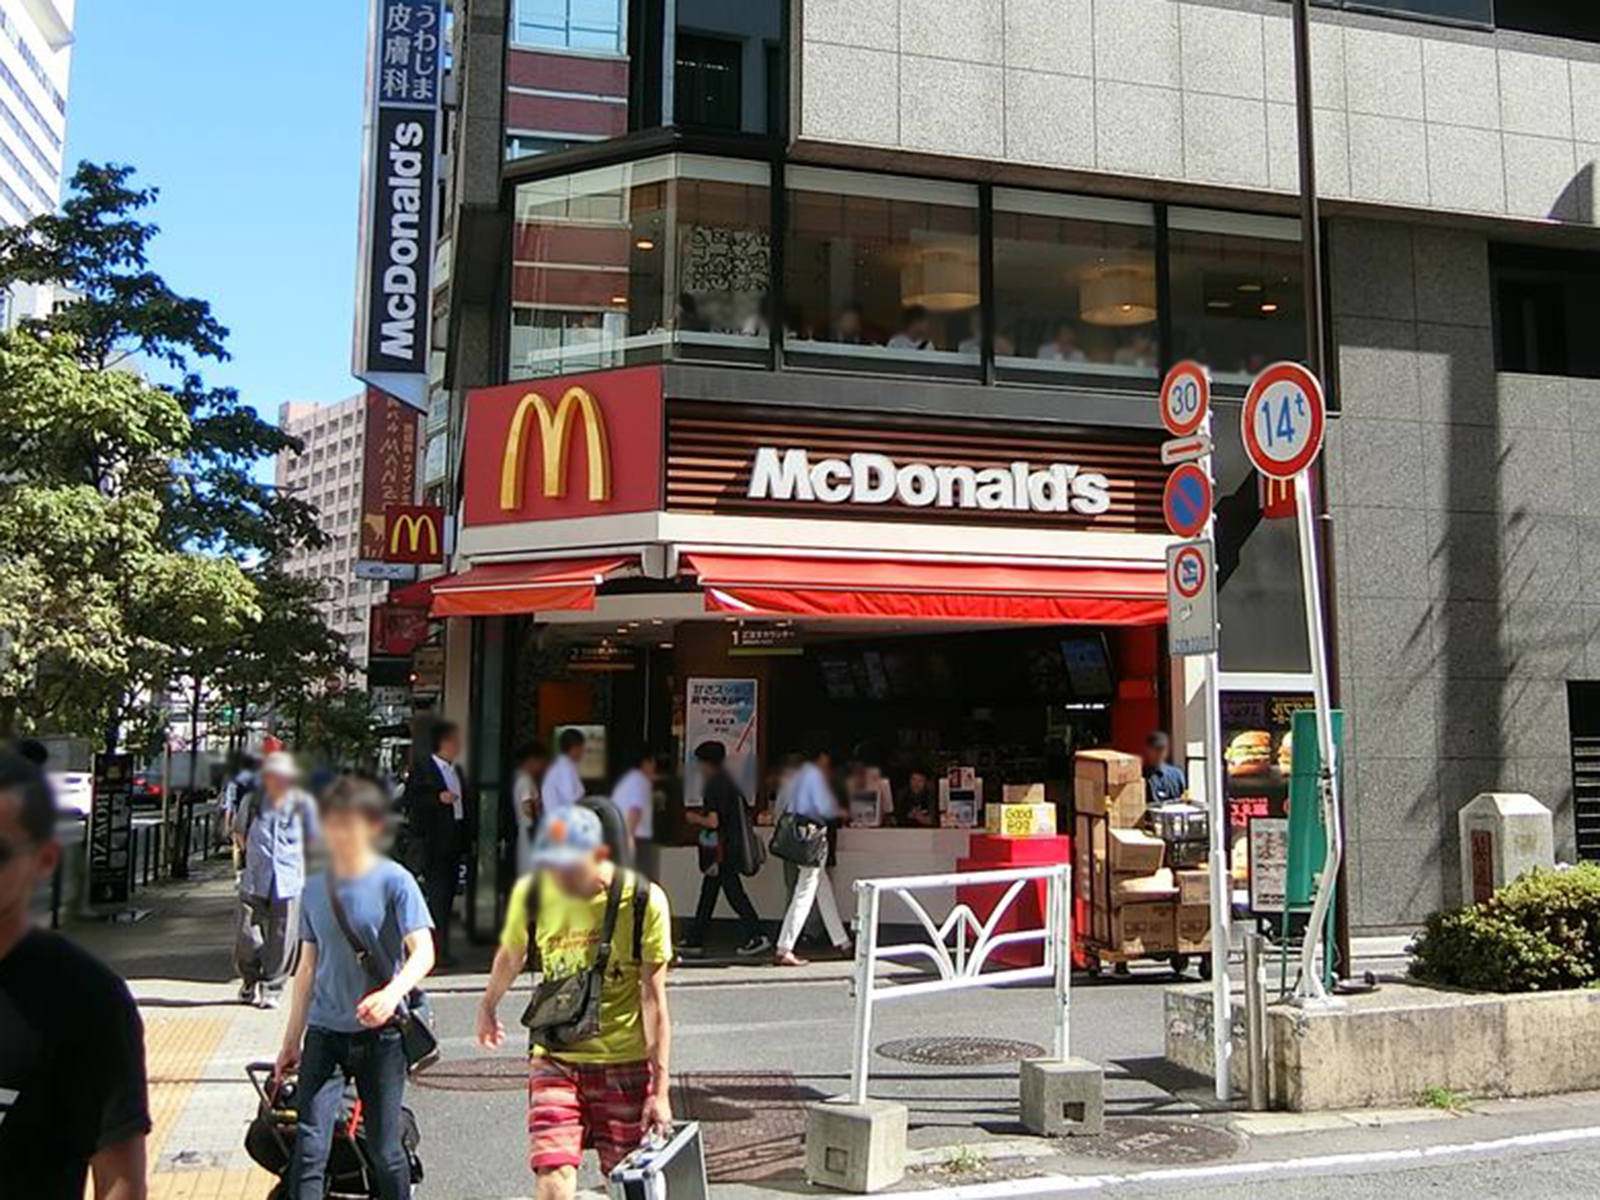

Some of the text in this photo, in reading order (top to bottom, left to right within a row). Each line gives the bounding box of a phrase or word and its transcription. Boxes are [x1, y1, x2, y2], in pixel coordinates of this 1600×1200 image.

[383, 3, 412, 98] 皮膚科
[412, 5, 437, 100] うわじま
[380, 121, 425, 361] McDonald's
[1170, 382, 1198, 416] 30
[746, 446, 1111, 515] McDonald's
[731, 630, 740, 645] 1
[1005, 807, 1033, 819] Good
